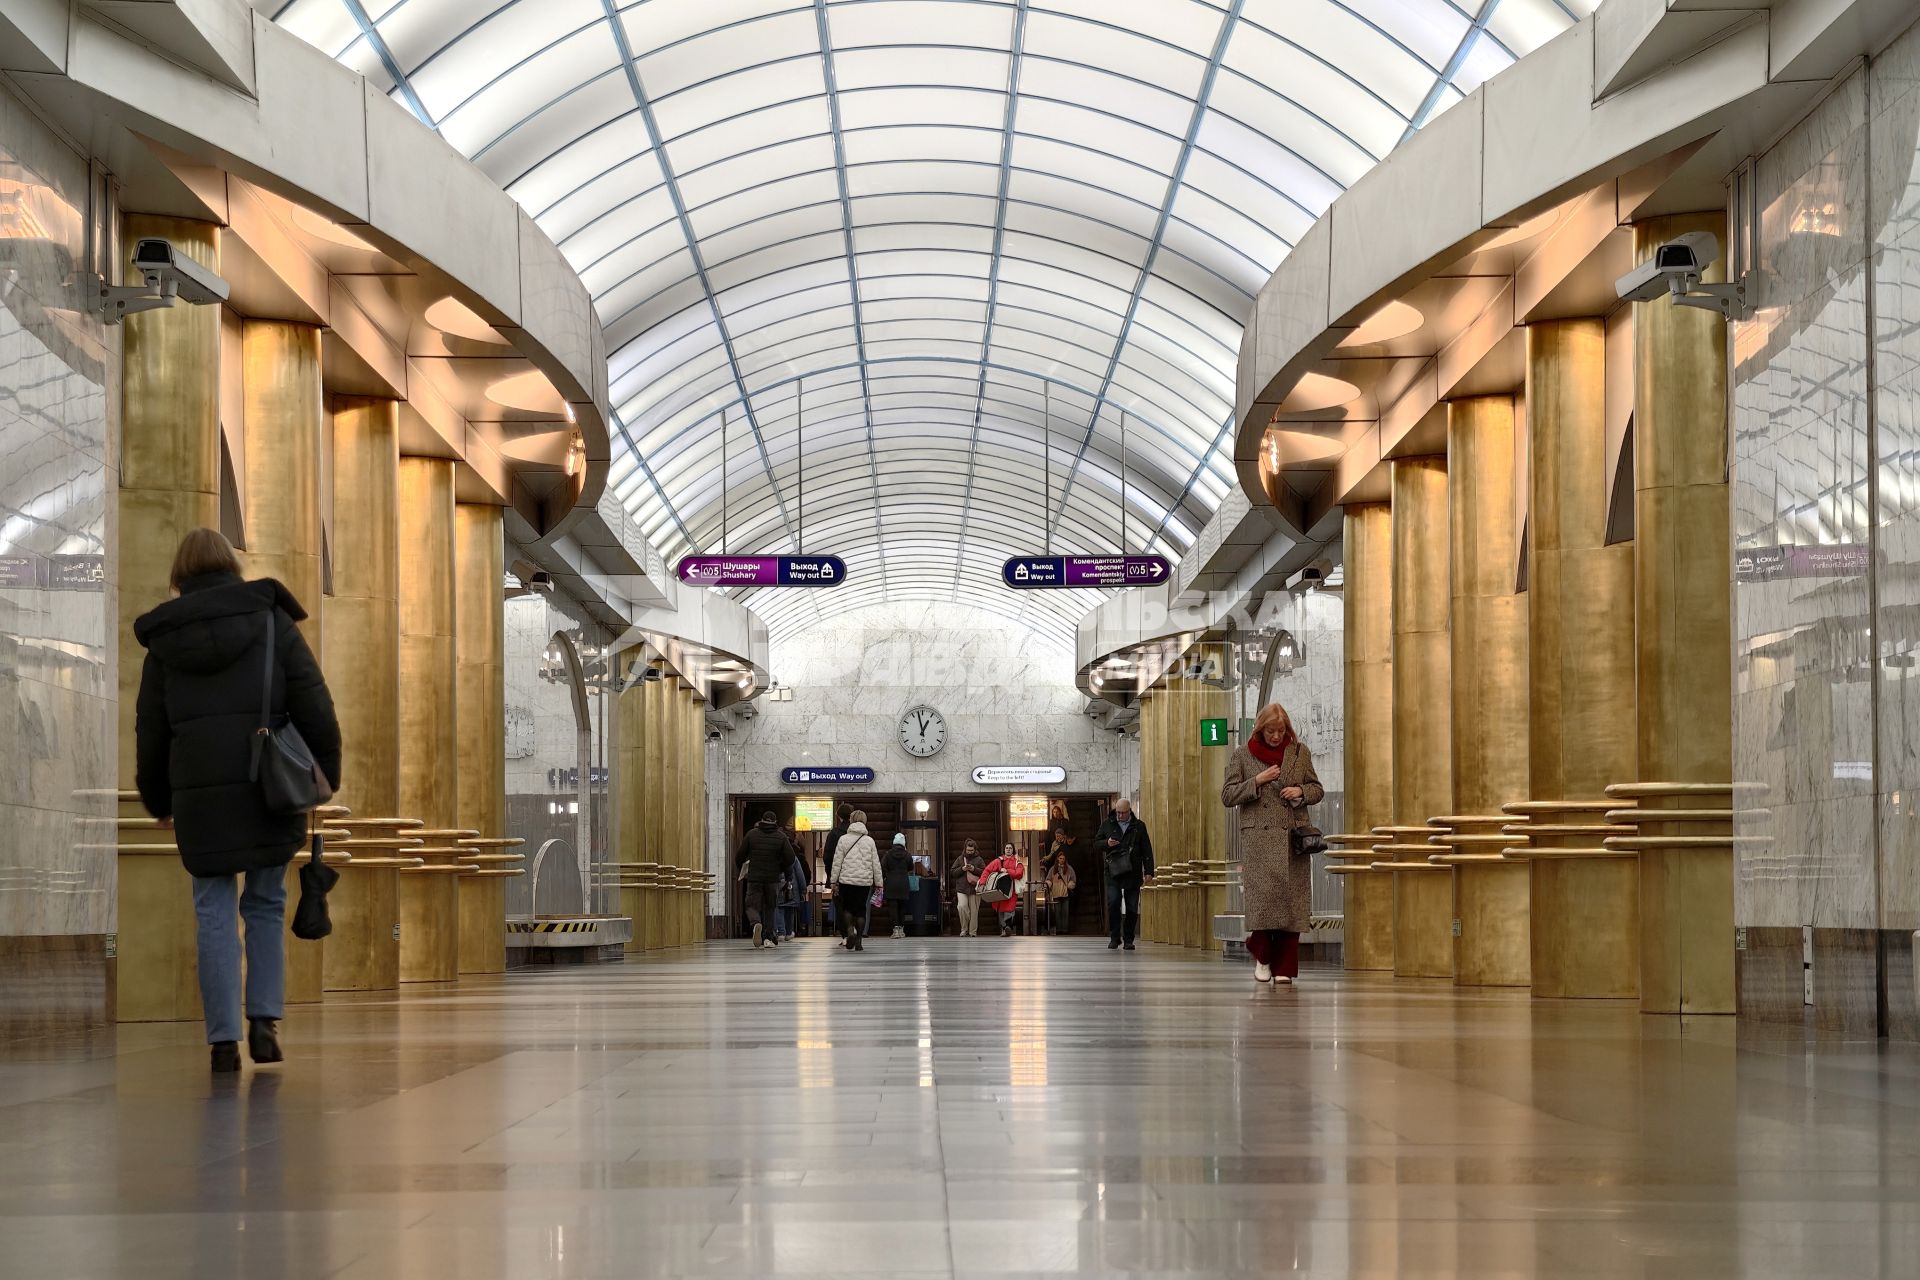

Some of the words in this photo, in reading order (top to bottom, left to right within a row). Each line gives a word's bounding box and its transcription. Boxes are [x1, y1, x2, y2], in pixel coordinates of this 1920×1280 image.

[1073, 557, 1125, 565] Комендантский
[722, 562, 761, 573] Шушары
[790, 562, 819, 572] Выход
[1031, 563, 1054, 572] Выход
[722, 571, 757, 581] Shushary
[790, 572, 806, 581] Way
[1030, 573, 1044, 582] Way
[1045, 573, 1056, 581] out
[1081, 571, 1125, 579] Komendantskiy
[1100, 578, 1125, 586] prospekt
[811, 772, 837, 781] Выход
[838, 772, 855, 781] Way
